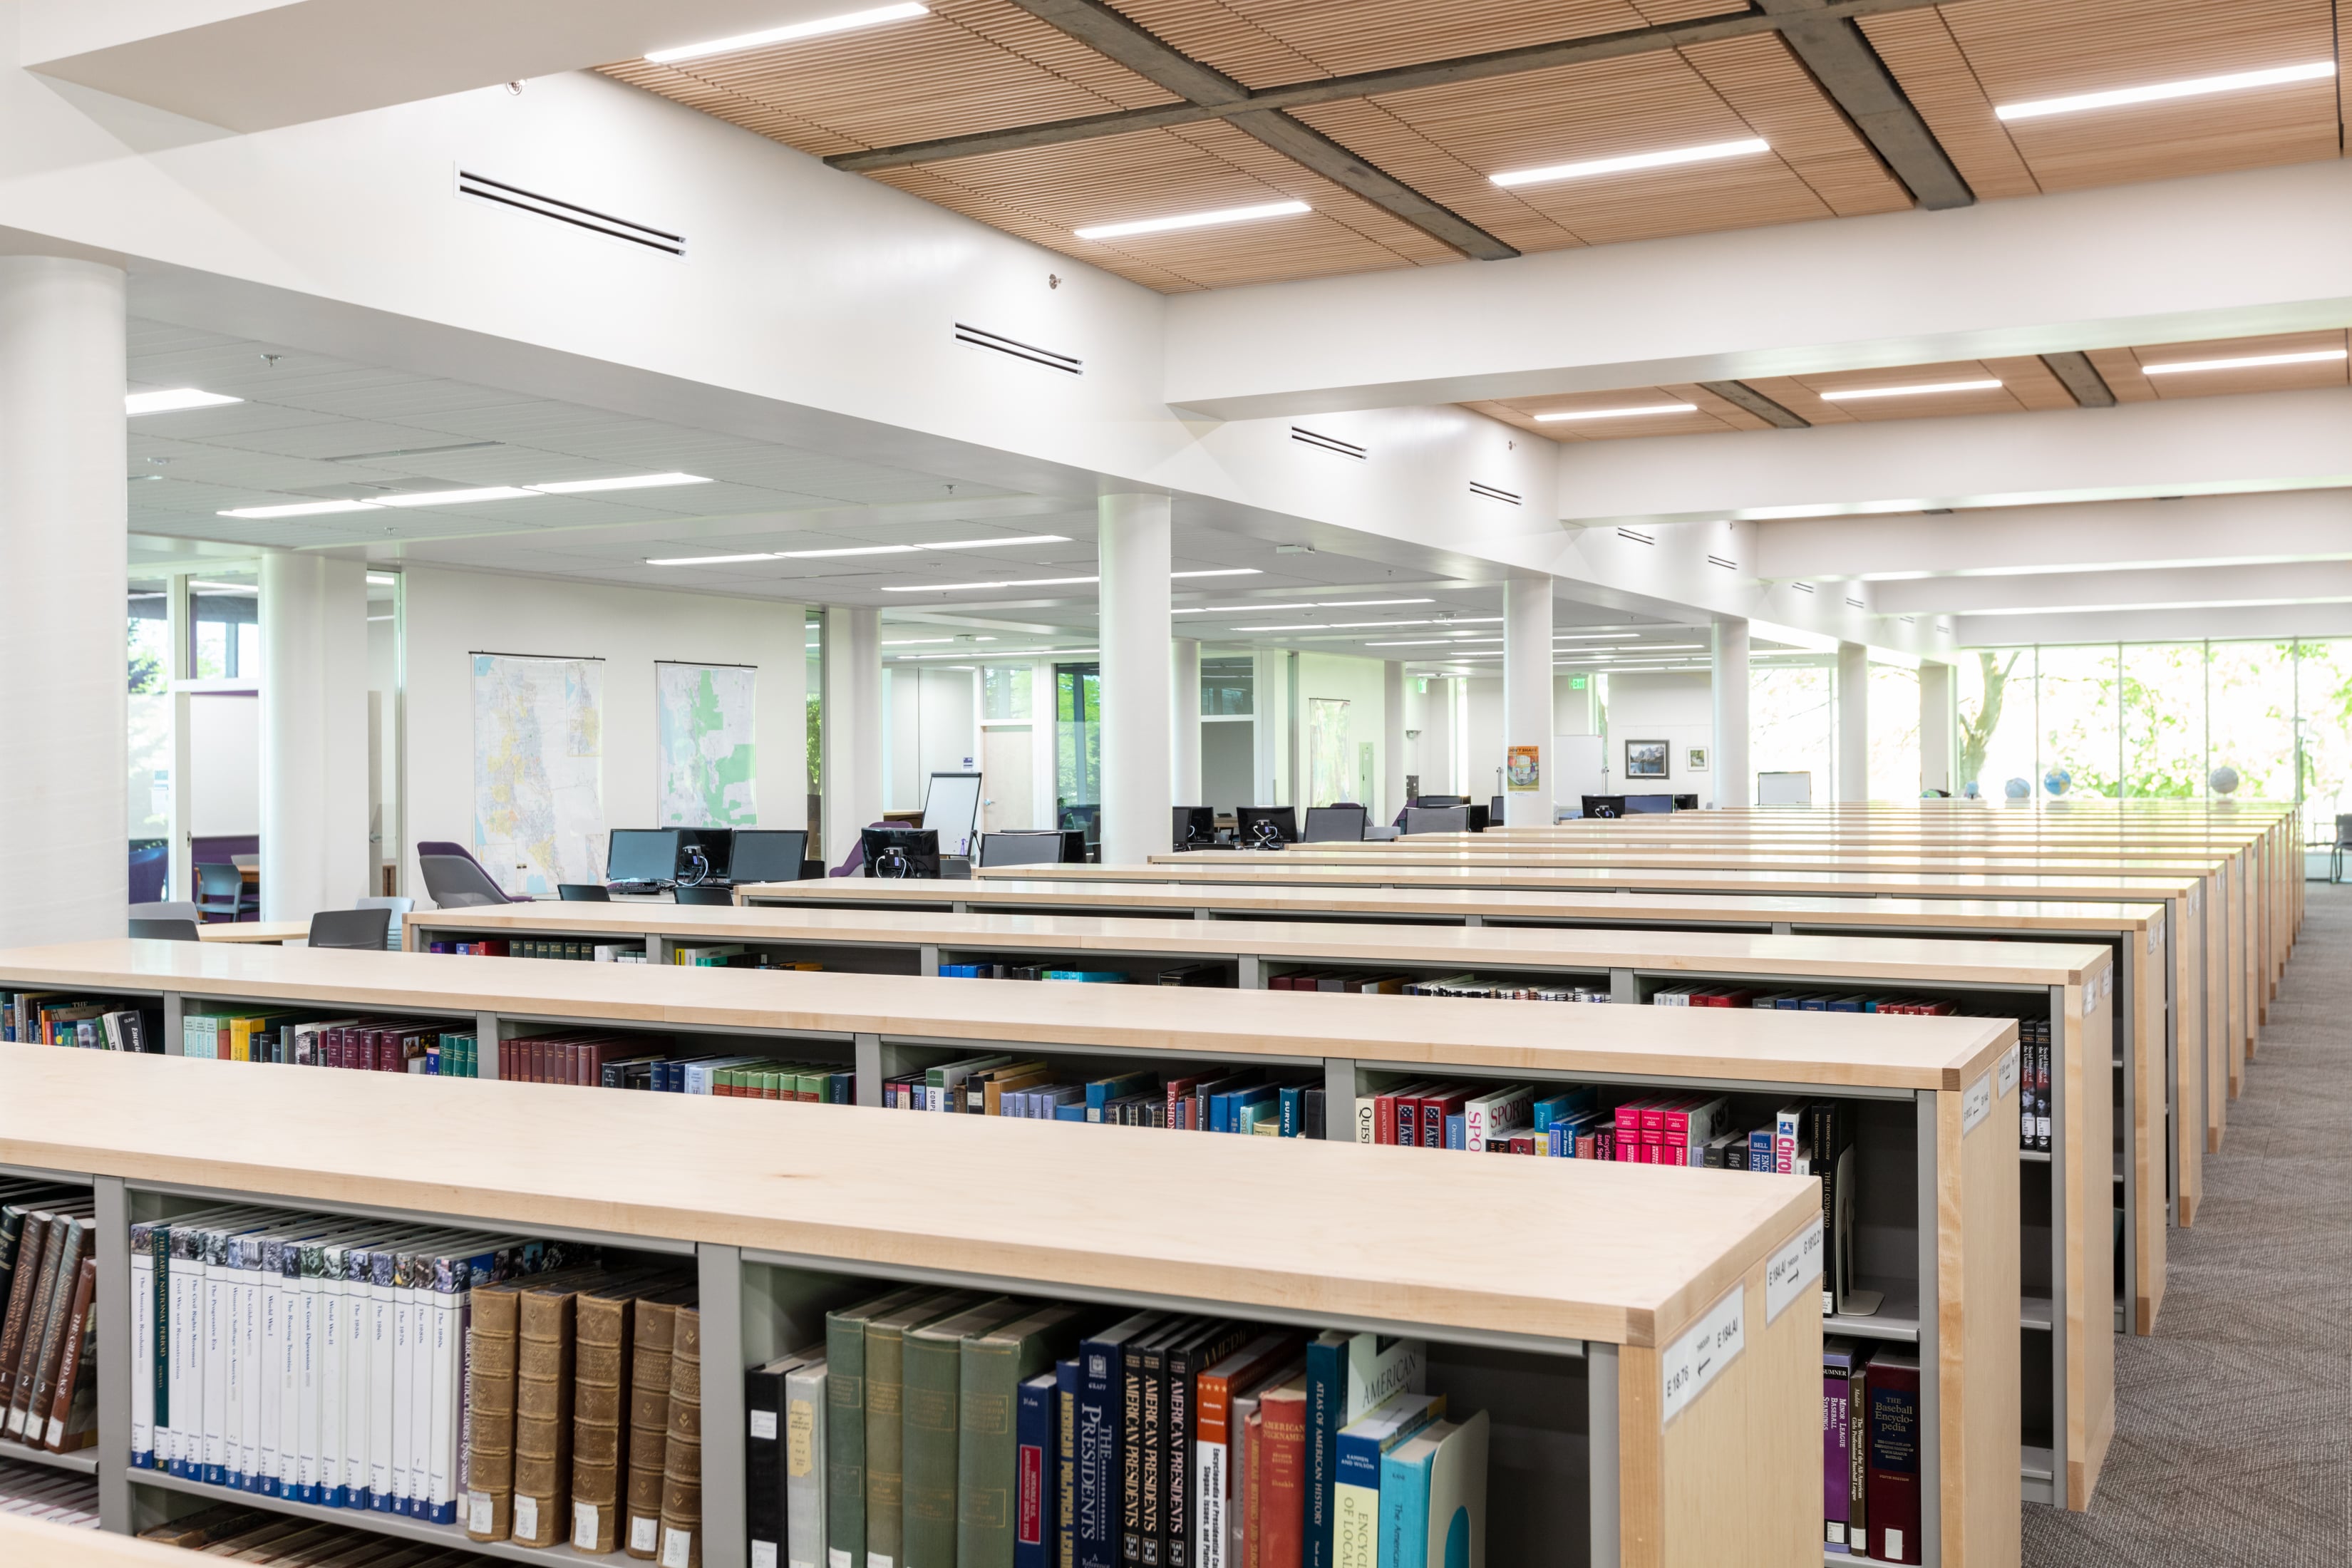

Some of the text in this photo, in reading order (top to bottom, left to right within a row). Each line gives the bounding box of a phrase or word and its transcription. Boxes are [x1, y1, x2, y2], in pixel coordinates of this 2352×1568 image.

[1573, 679, 1586, 689] EXIT
[1769, 1271, 1773, 1286] E
[1788, 1254, 1799, 1269] THROUGH
[1804, 1240, 1807, 1255] G
[1, 1372, 6, 1383] 1
[1363, 1349, 1418, 1408] AMERICAN
[1667, 1380, 1672, 1398] E
[1673, 1365, 1689, 1393] 18.76
[1696, 1334, 1711, 1353] THROUGH
[1717, 1331, 1722, 1348] E
[21, 1376, 29, 1386] 2
[40, 1381, 46, 1393] 3
[1125, 1372, 1139, 1443] AMERICAN
[1875, 1402, 1913, 1415] Baseball
[1875, 1411, 1914, 1424] Encyclo-
[1264, 1420, 1306, 1433] AMERICAN
[1264, 1431, 1306, 1442] NICKNAMES
[1882, 1423, 1907, 1432] pedia
[1100, 1425, 1112, 1460] THE
[1143, 1375, 1157, 1532] AMERICAN PRESIDENTS
[1169, 1377, 1184, 1533] AMERICAN PRESIDENTS
[1314, 1381, 1324, 1527] ATLAS OF AMERICAN HISTORY
[460, 1441, 468, 1484] 1789-2000
[1061, 1391, 1073, 1528] AMERICAN POLITICAL
[1080, 1403, 1101, 1539] PRESIDENTS
[1212, 1448, 1220, 1498] Encyclopedia
[1353, 1460, 1375, 1470] WILSON
[1125, 1444, 1138, 1527] PRESIDENTS
[1343, 1497, 1354, 1523] OF
[1393, 1502, 1403, 1520] The
[1125, 1549, 1137, 1557] YEAR
